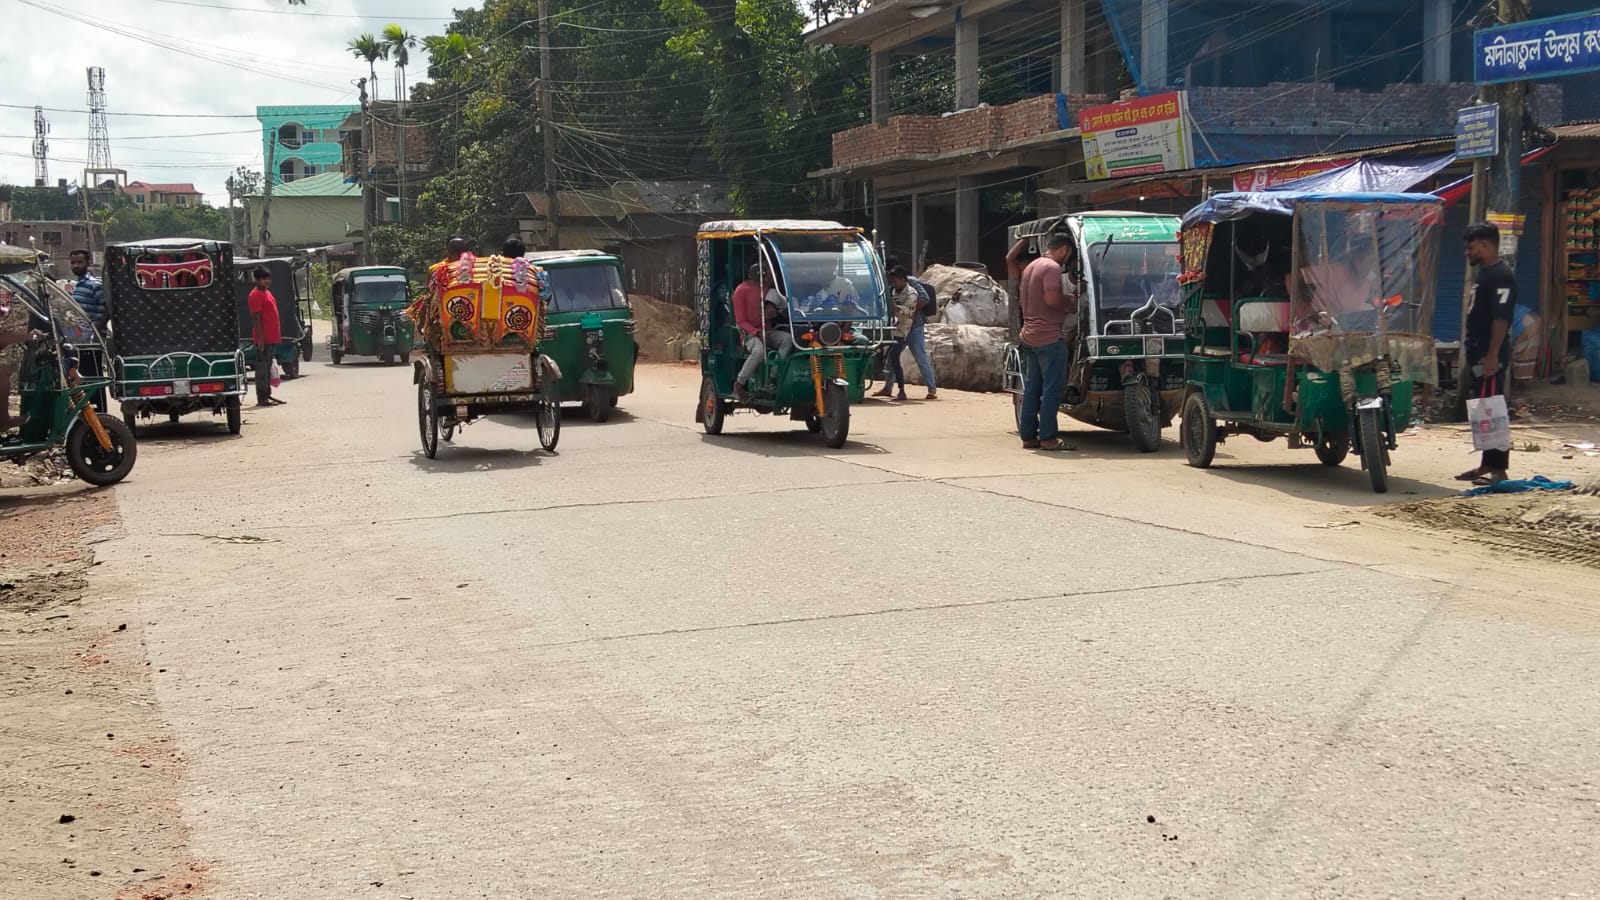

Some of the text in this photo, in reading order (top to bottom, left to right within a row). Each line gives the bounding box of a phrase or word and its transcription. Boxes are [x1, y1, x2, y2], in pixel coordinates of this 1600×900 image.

[1484, 35, 1542, 71] মদীনাতুল
[1544, 29, 1581, 63] উলূম
[1496, 287, 1510, 304] 7
